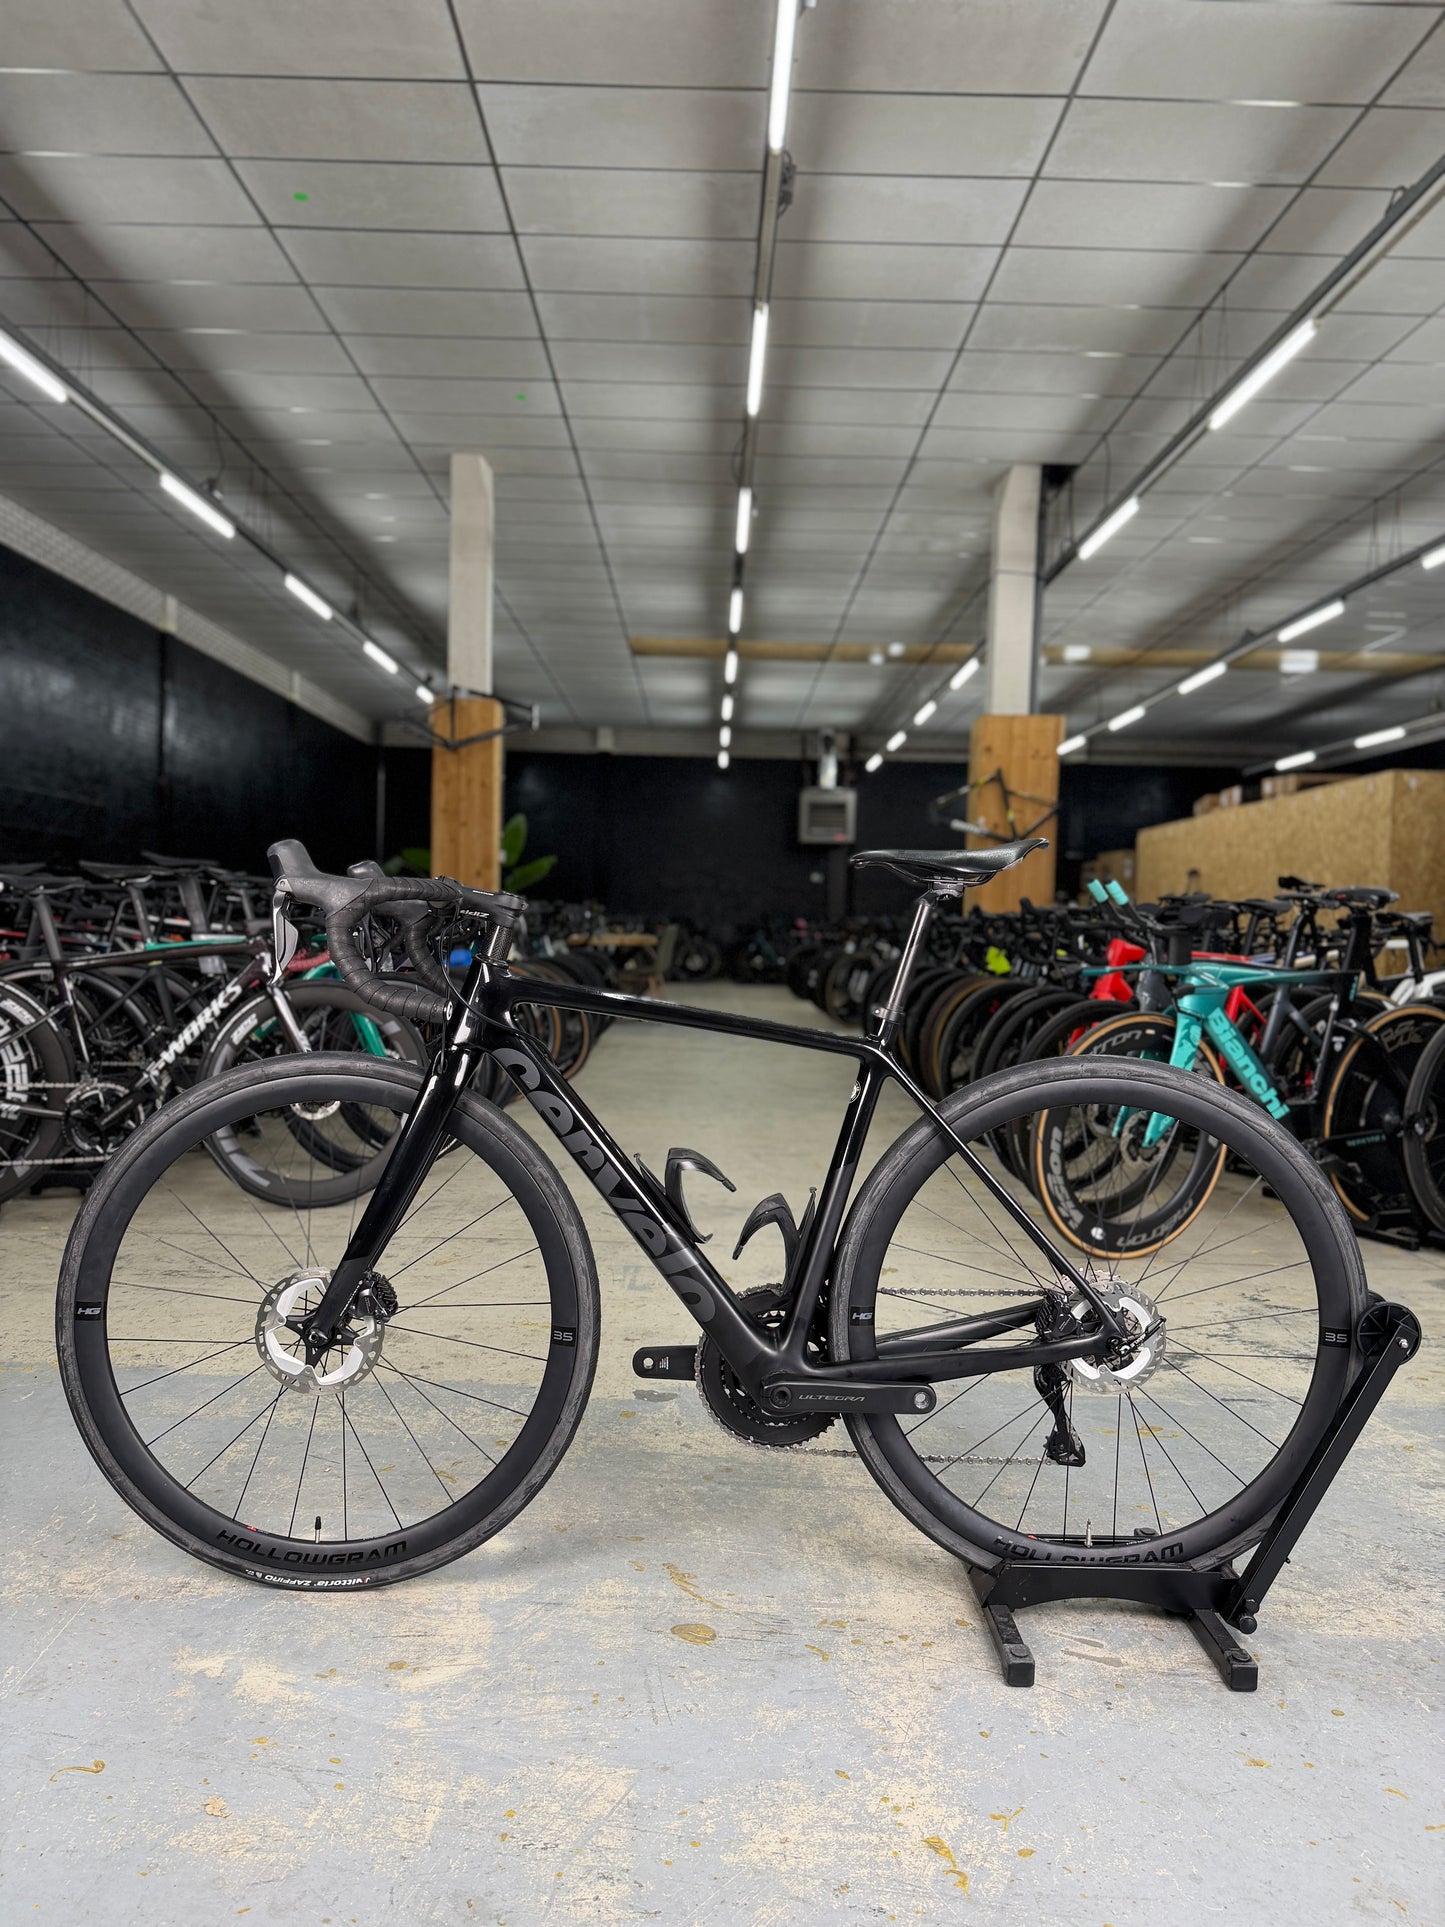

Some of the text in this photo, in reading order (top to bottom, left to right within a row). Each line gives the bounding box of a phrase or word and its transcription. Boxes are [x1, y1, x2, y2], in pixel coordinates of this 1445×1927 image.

[1207, 1007, 1290, 1120] Bianchi
[77, 1307, 101, 1315] HG
[852, 1312, 873, 1320] HG
[553, 1330, 573, 1341] 35
[1325, 1332, 1348, 1343] 35
[799, 1394, 865, 1402] ULTEGRA
[216, 1529, 407, 1566] HOLLOWGRAM
